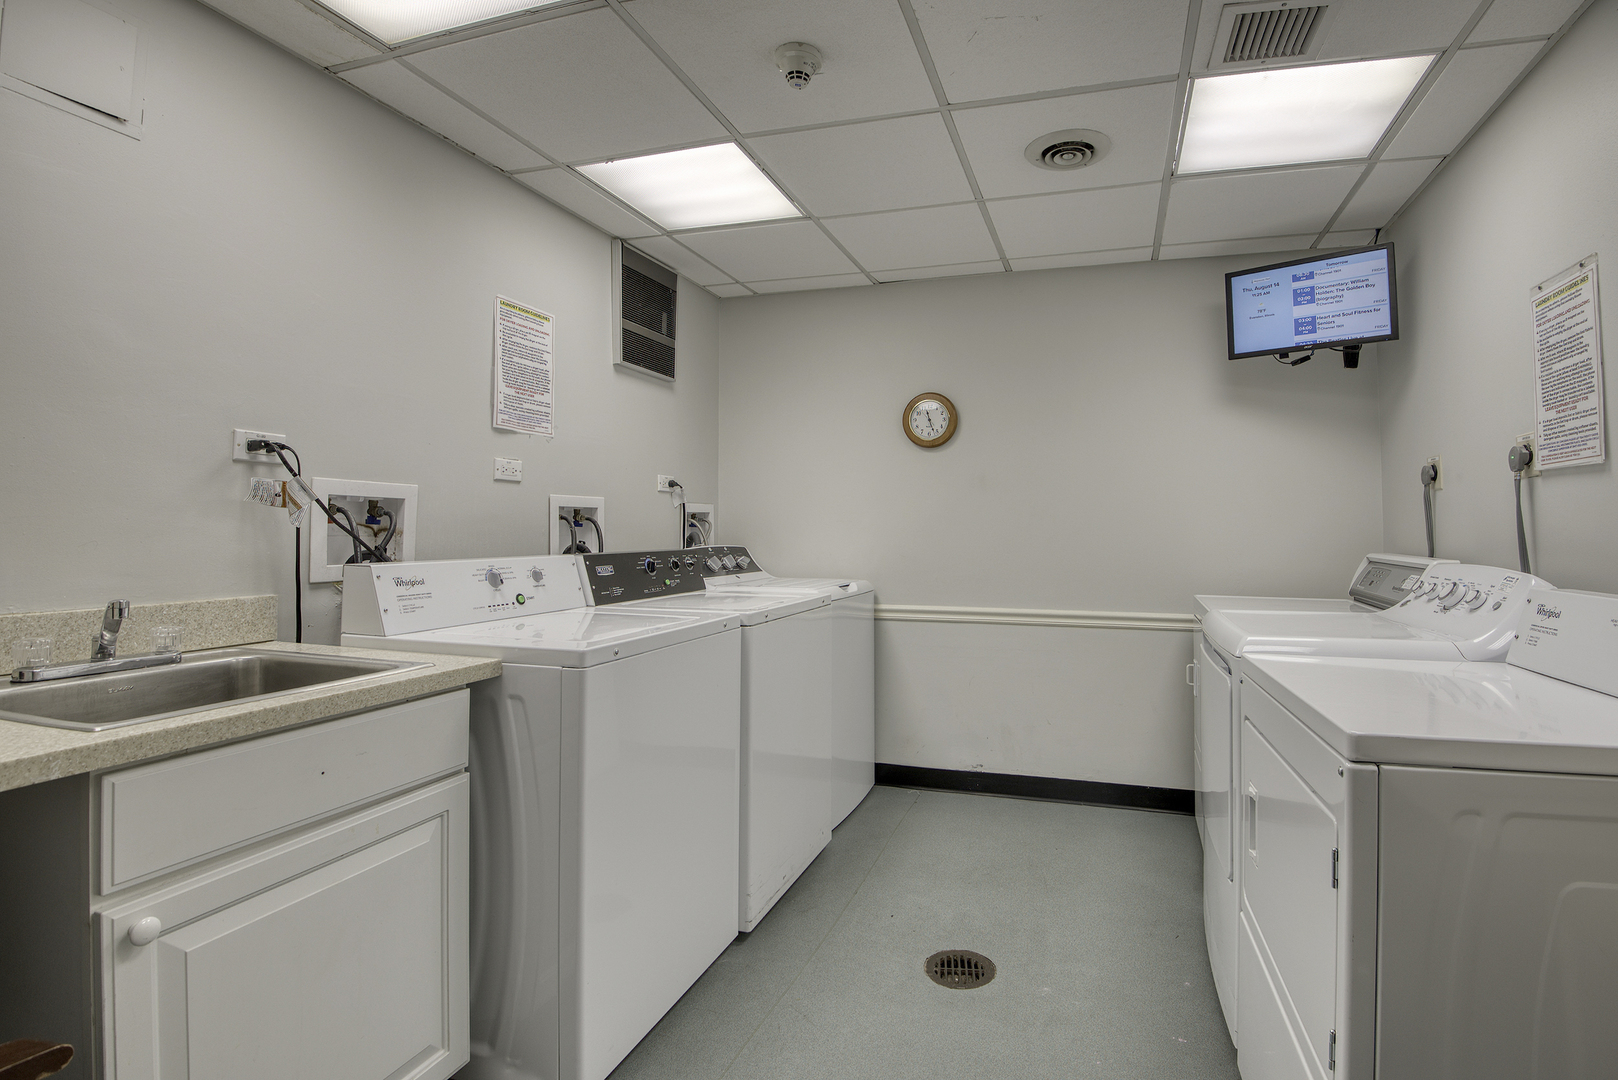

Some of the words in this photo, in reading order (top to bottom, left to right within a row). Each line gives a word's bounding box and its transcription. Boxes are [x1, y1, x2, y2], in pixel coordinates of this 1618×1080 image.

[1316, 281, 1349, 291] Documentary:
[1553, 288, 1564, 298] ROOM
[1565, 274, 1589, 291] GUIDELINES
[1316, 294, 1344, 302] (biography)
[394, 578, 425, 587] Whirlpool
[1536, 607, 1562, 619] Whirlpool
